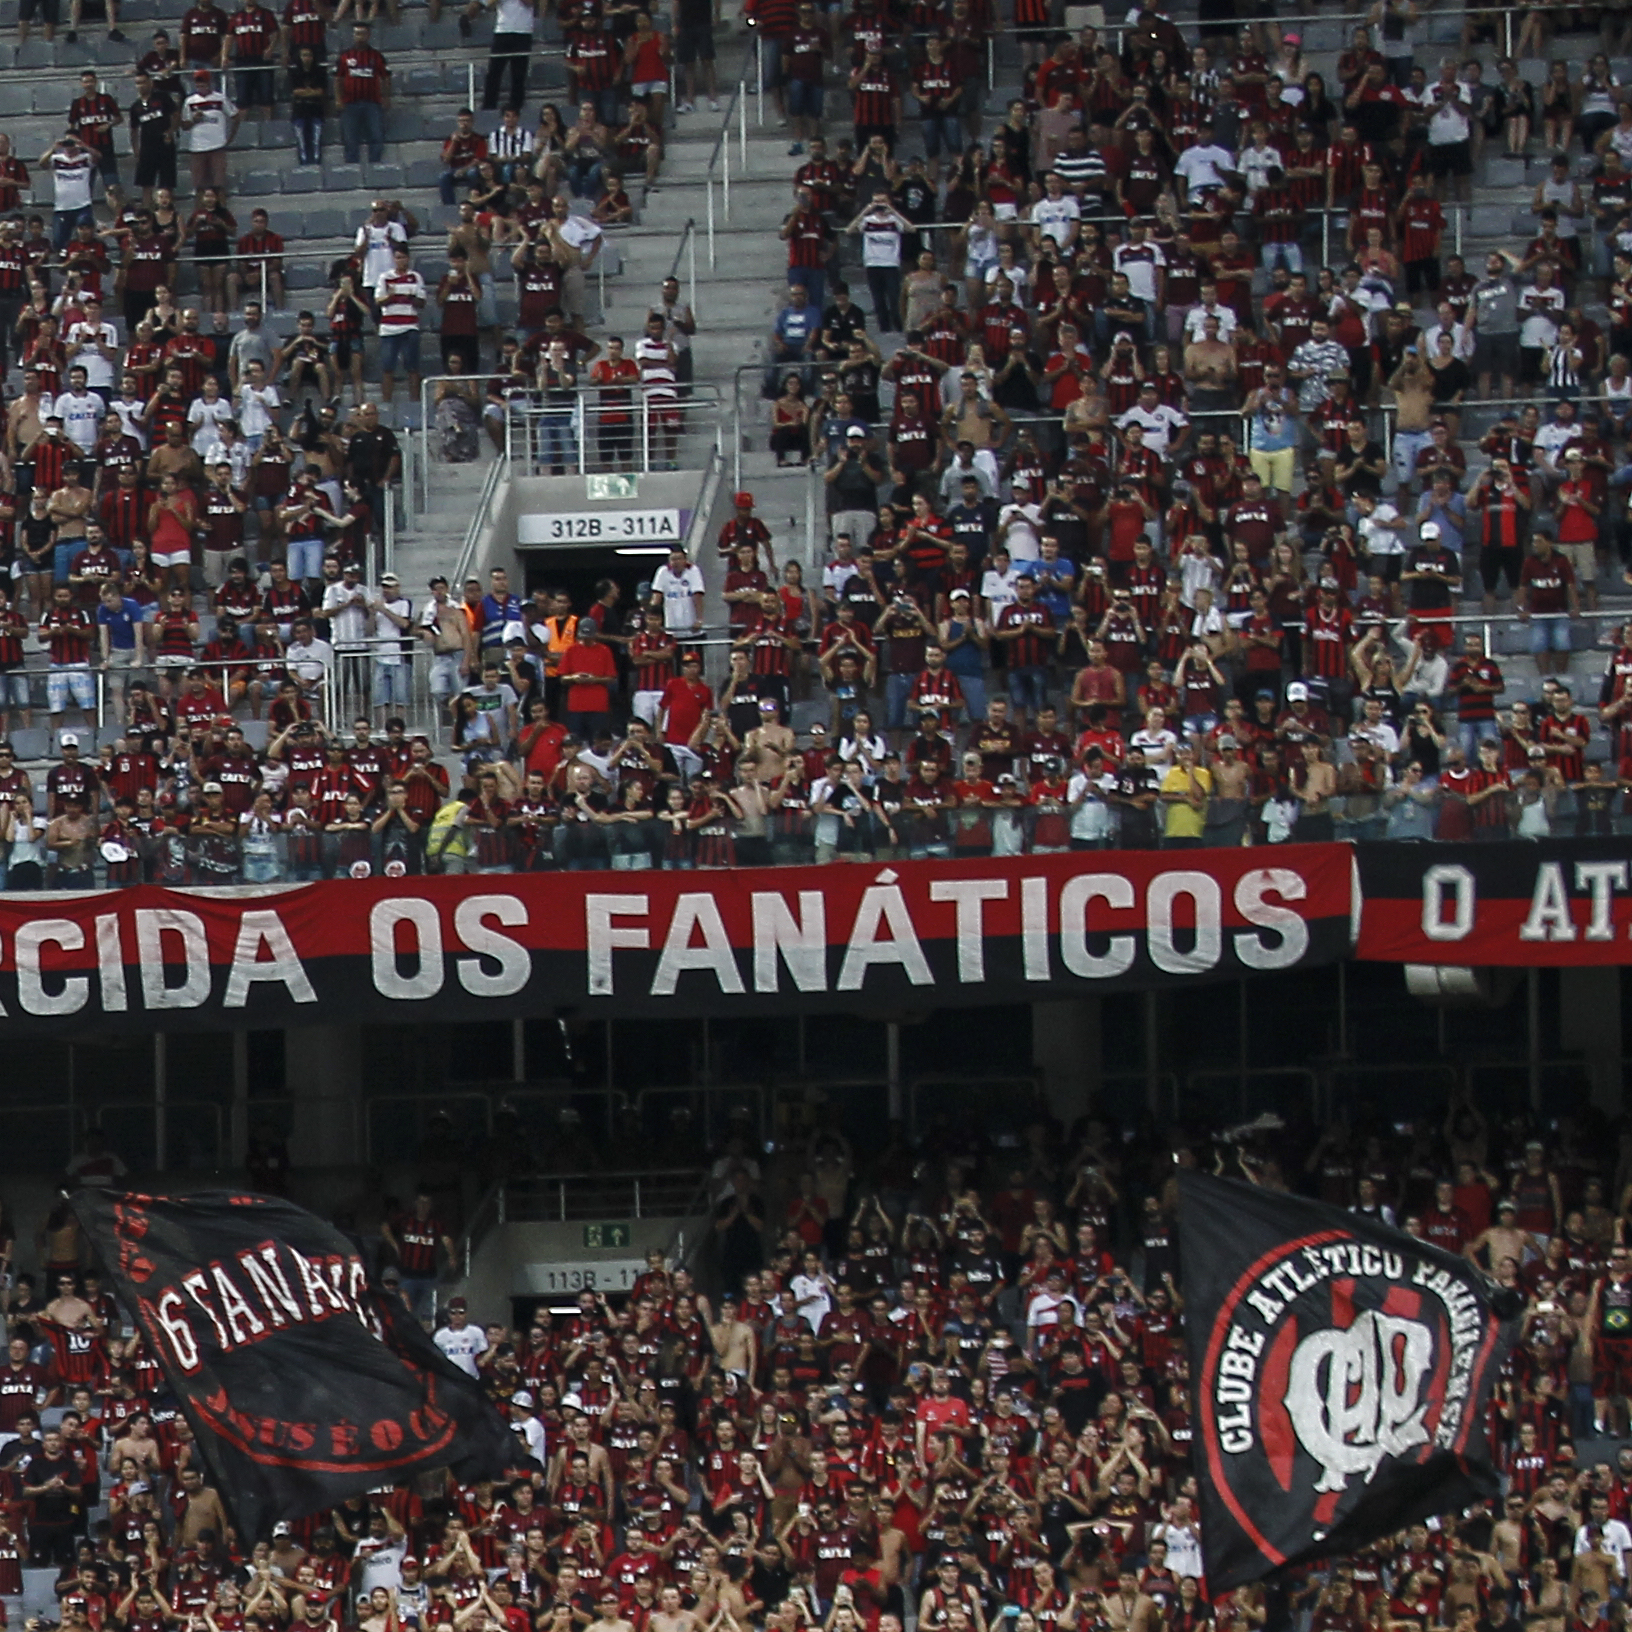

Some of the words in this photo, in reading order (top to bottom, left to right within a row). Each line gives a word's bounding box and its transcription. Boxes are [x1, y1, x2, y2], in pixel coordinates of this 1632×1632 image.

[551, 518, 602, 538] 312B
[622, 516, 672, 536] 311A
[1421, 864, 1476, 942] O
[1520, 860, 1632, 942] AT
[369, 894, 532, 1000] OS
[585, 867, 1308, 996] FANÁTICOS
[548, 1270, 598, 1292] 113B
[1216, 1324, 1265, 1455] CLUBE
[1247, 1244, 1404, 1326] ATLÉTICO
[1, 1384, 33, 1394] CAIXA
